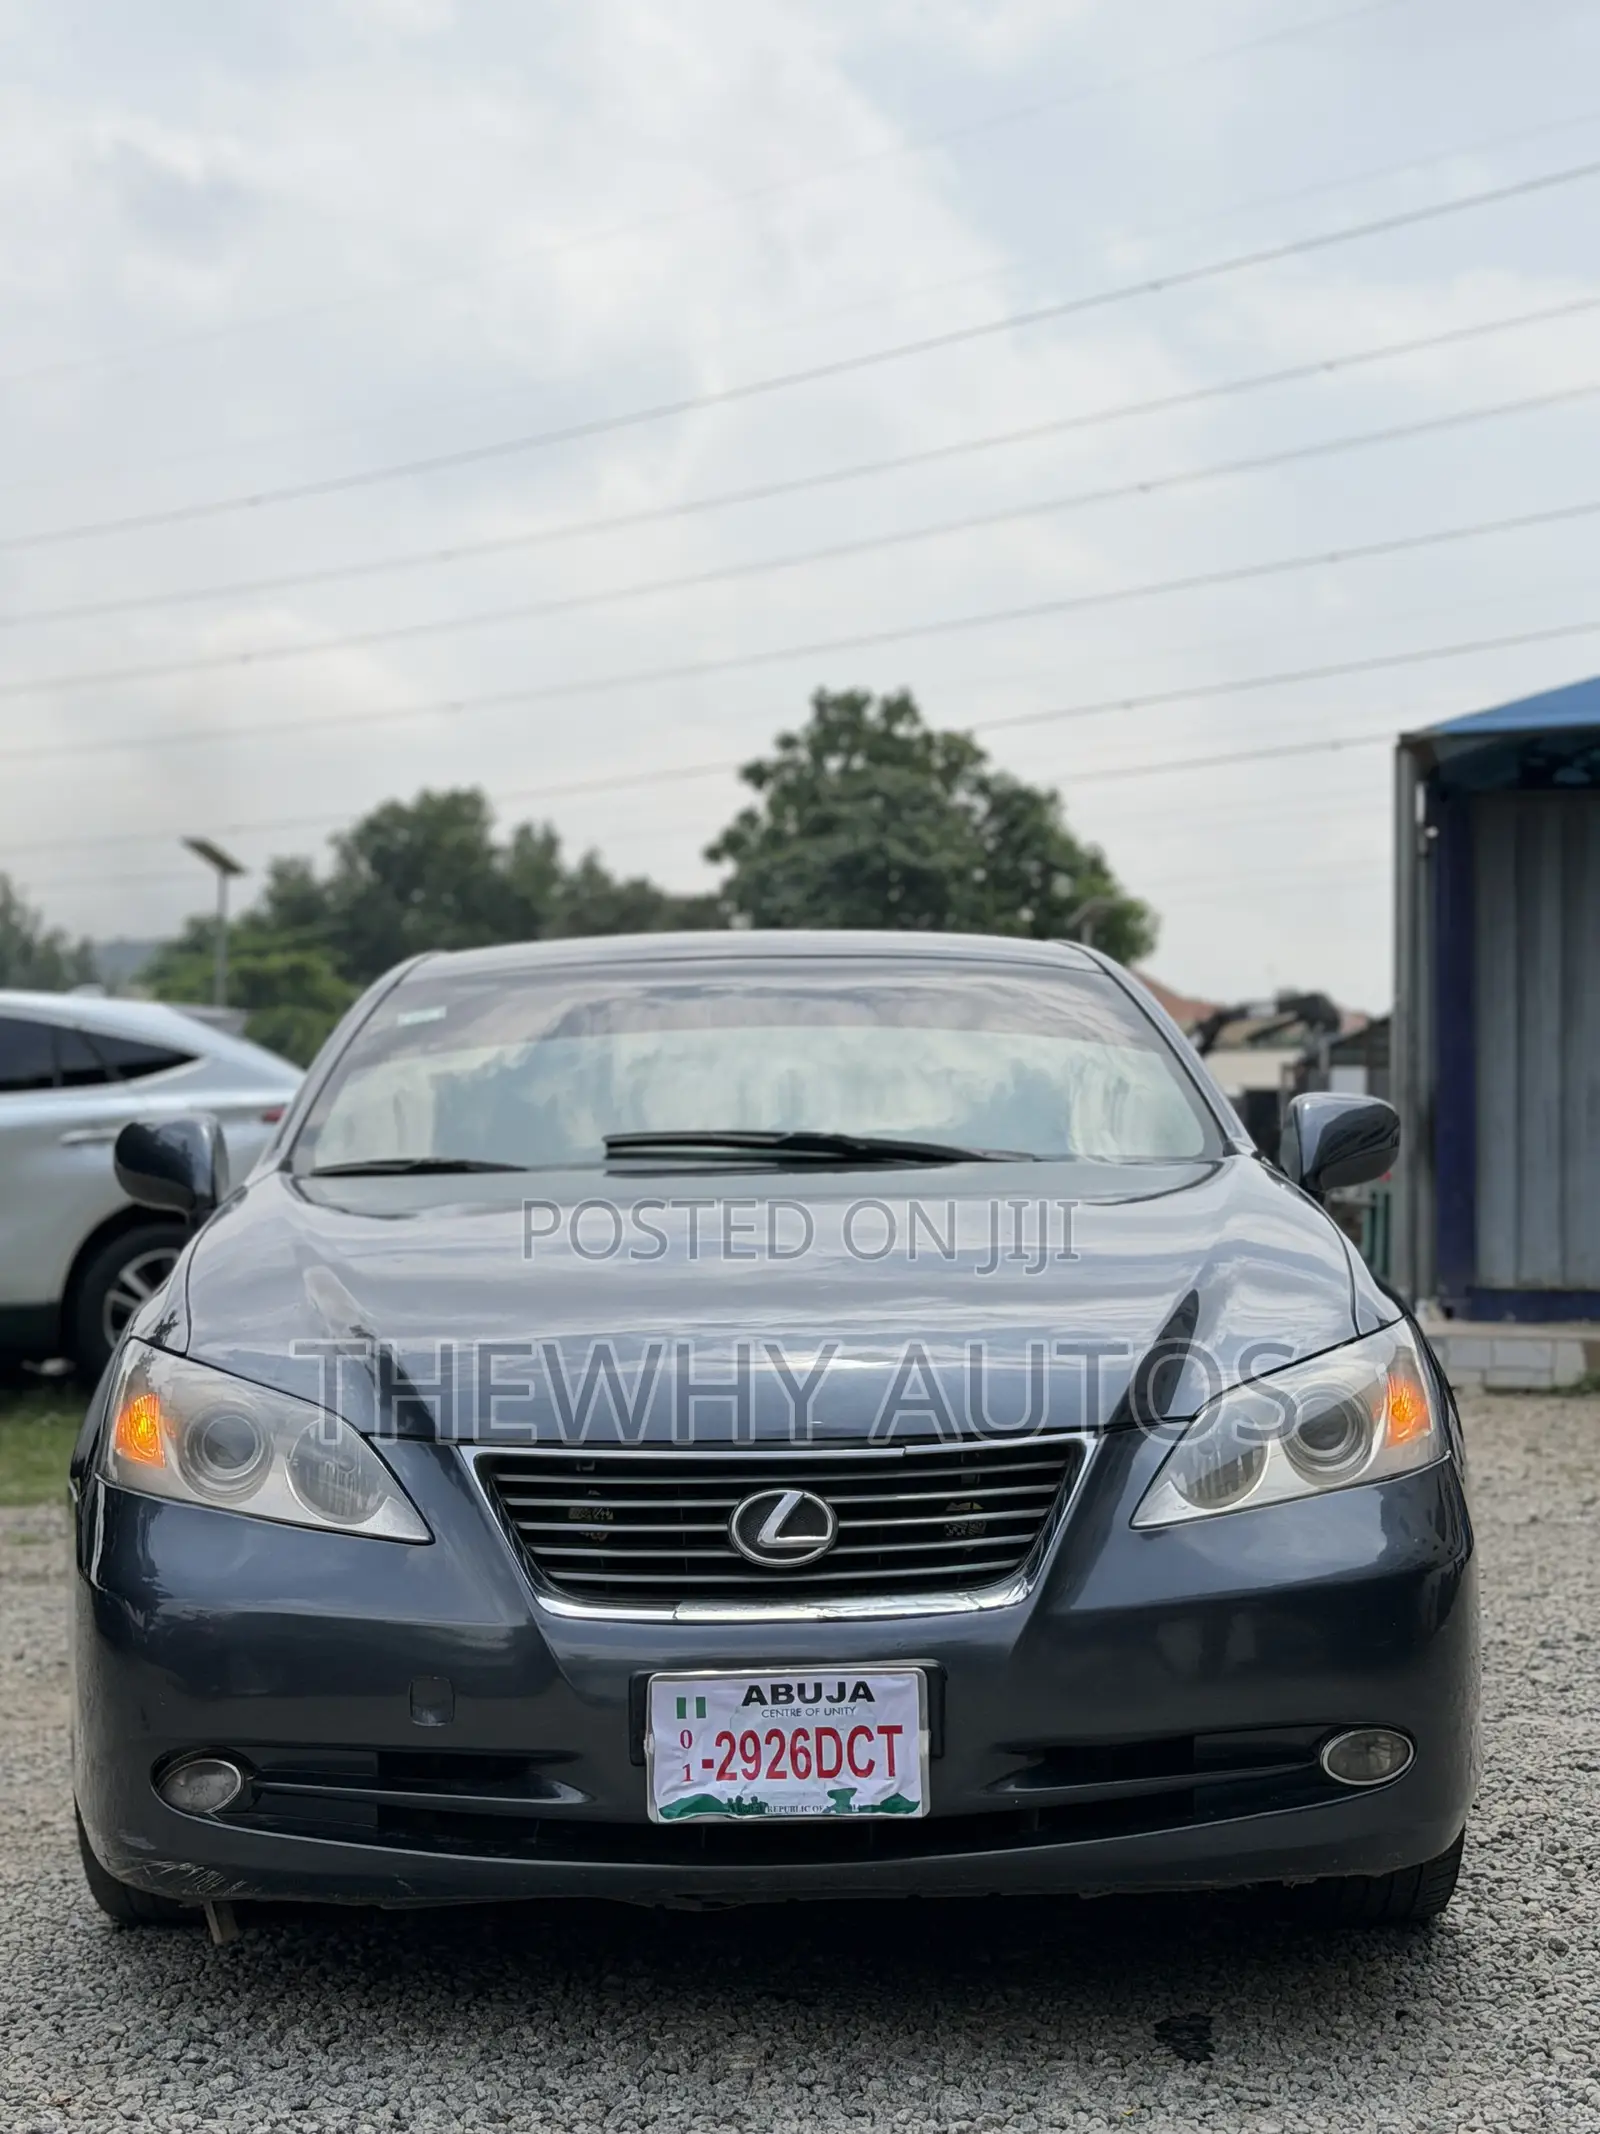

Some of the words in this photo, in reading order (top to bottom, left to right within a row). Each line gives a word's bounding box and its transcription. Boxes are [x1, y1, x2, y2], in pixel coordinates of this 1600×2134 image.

[741, 1681, 876, 1707] ABUJA
[761, 1707, 802, 1718] CENTRE
[805, 1707, 820, 1717] OF
[824, 1706, 856, 1716] UNITY
[767, 1805, 810, 1814] REPUBLIC
